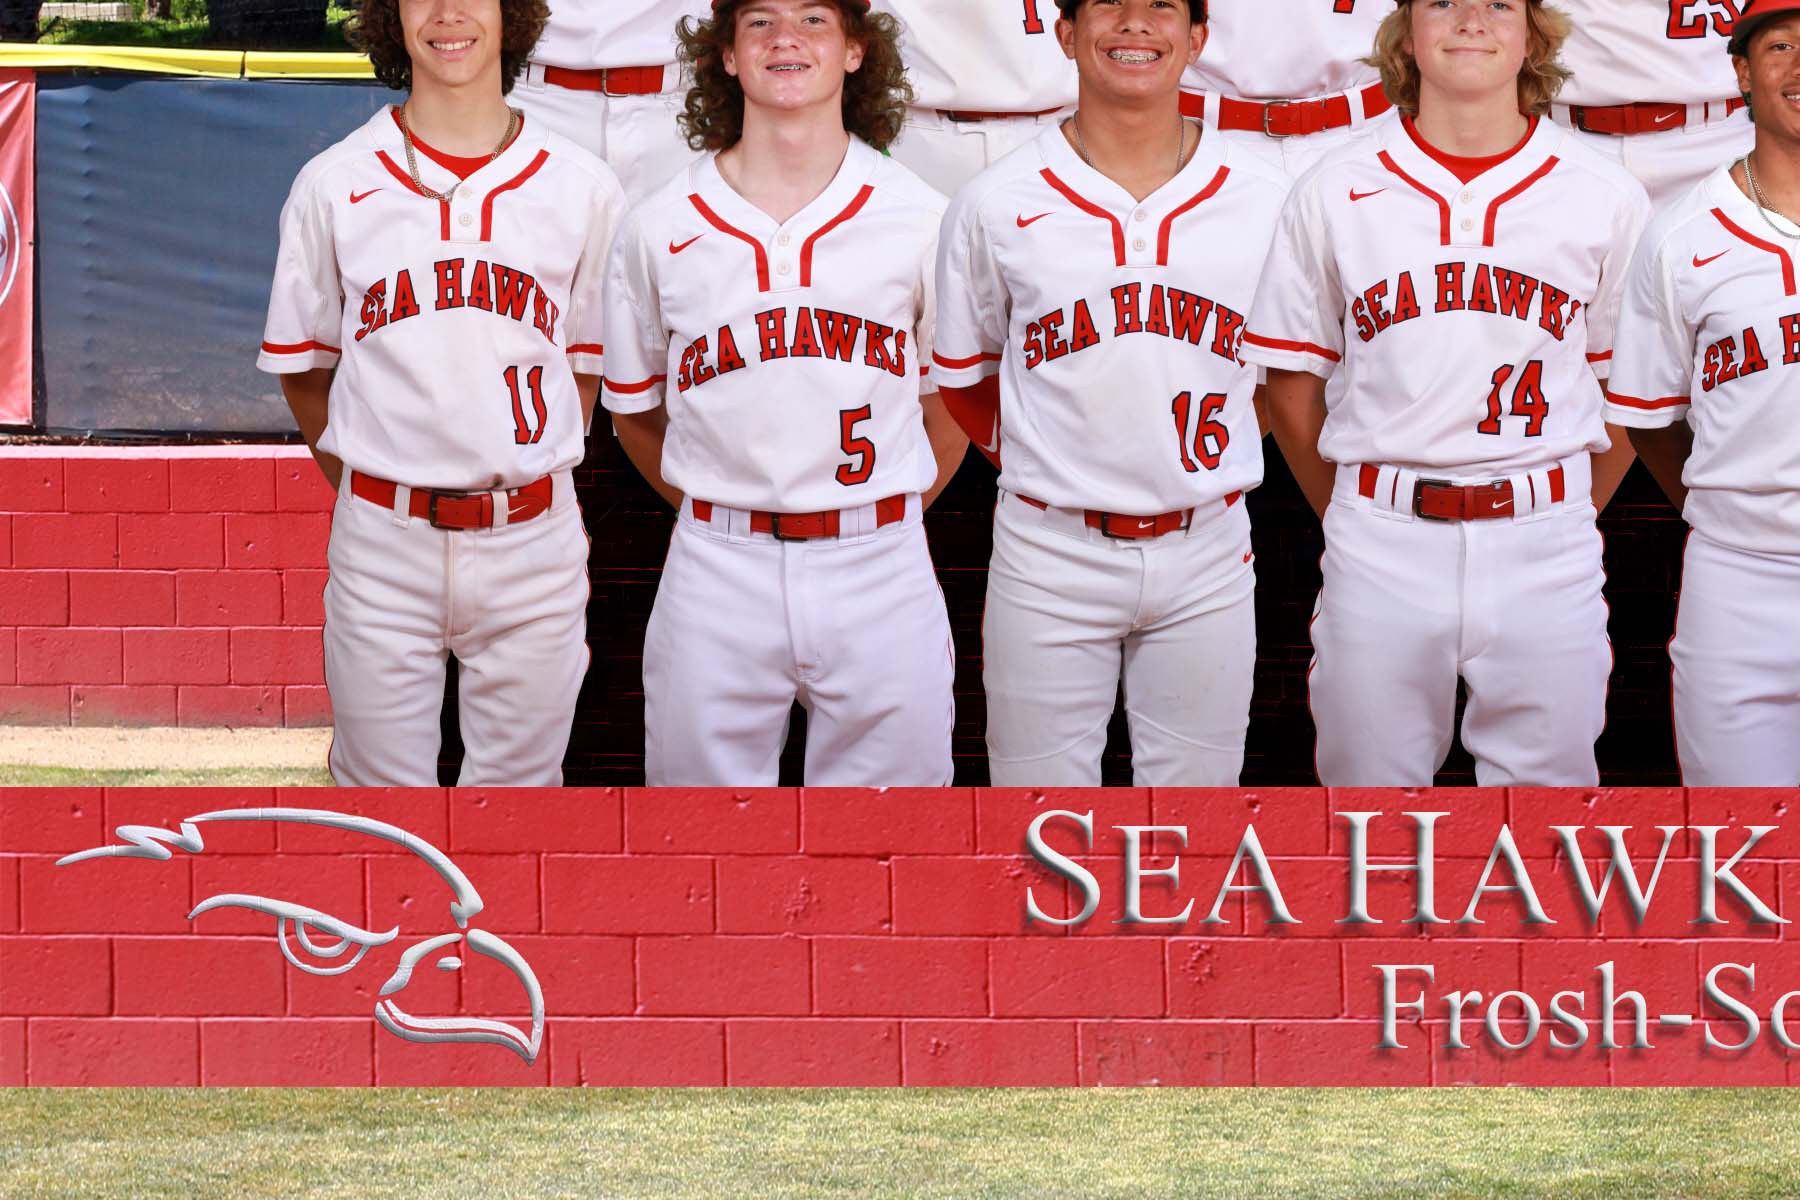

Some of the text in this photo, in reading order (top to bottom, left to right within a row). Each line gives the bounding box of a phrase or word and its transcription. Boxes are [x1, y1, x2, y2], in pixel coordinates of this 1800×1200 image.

[355, 268, 420, 343] SEA
[1023, 298, 1100, 370] SEA
[1351, 271, 1420, 342] SEA
[677, 306, 907, 394] SEA HAWKS
[1702, 325, 1768, 392] SEA
[502, 365, 547, 445] 11
[1171, 391, 1230, 473] 16
[1477, 358, 1550, 438] 14
[835, 403, 877, 487] 5
